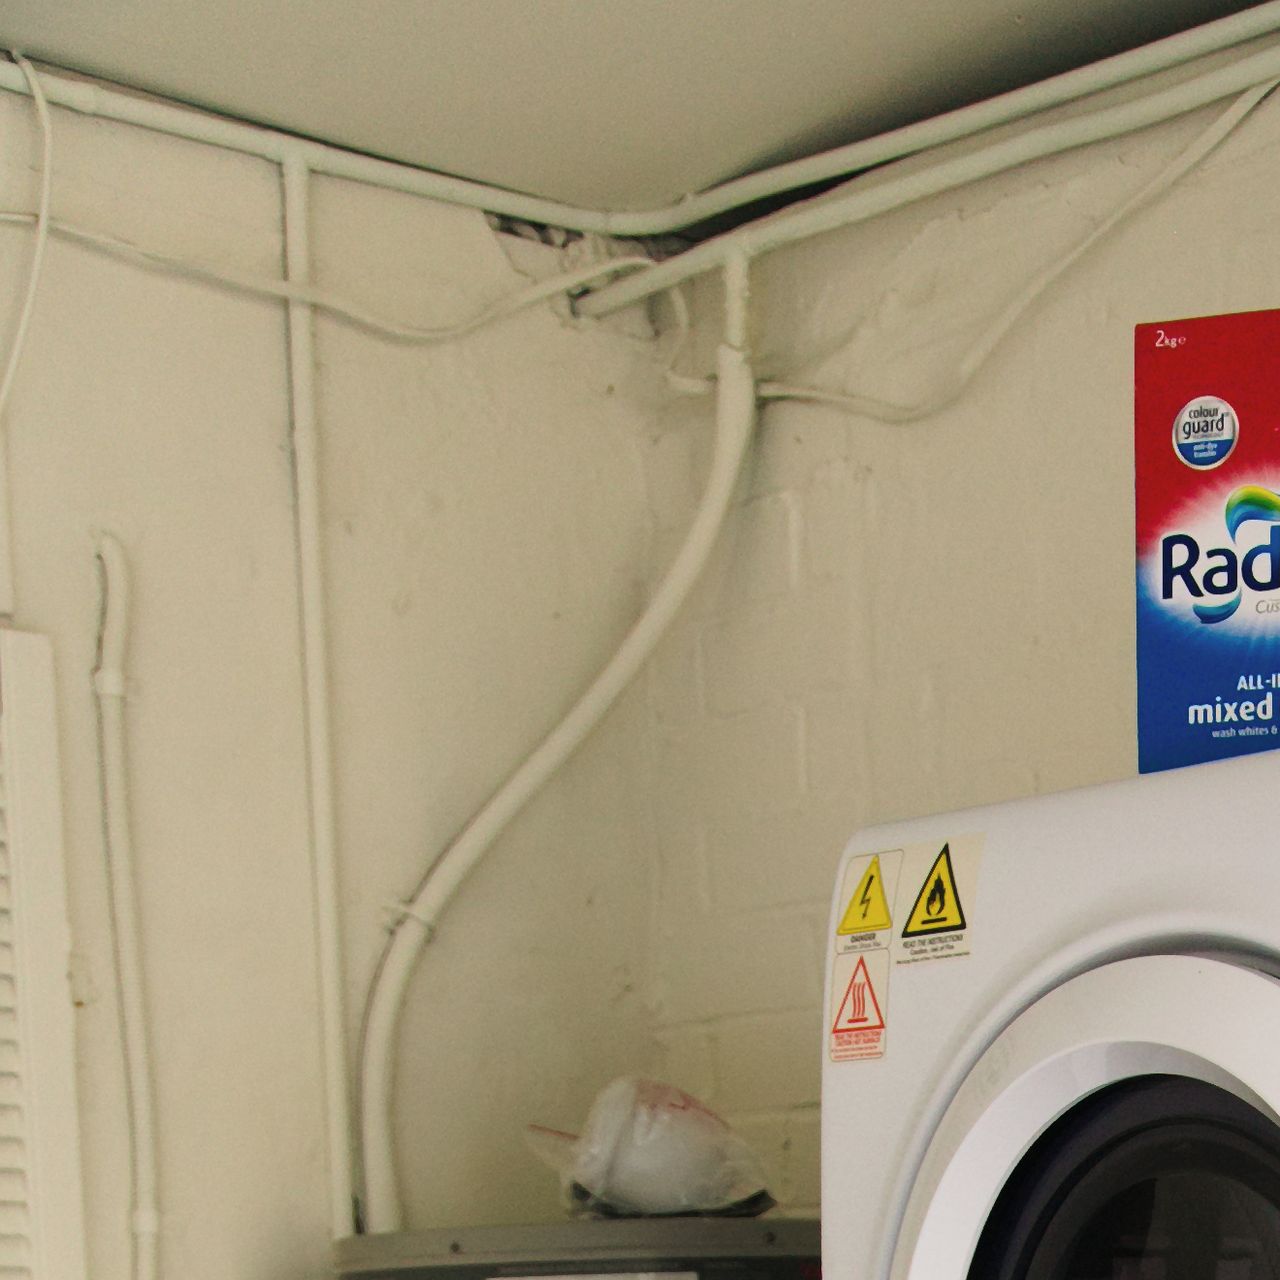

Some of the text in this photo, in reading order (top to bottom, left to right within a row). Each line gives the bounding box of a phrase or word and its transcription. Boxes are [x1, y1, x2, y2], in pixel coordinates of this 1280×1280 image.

[1188, 405, 1219, 419] colour
[1183, 413, 1224, 440] guard
[1188, 692, 1273, 724] mixed
[1212, 726, 1236, 738] wash
[1238, 724, 1269, 737] whites
[1270, 724, 1278, 734] &
